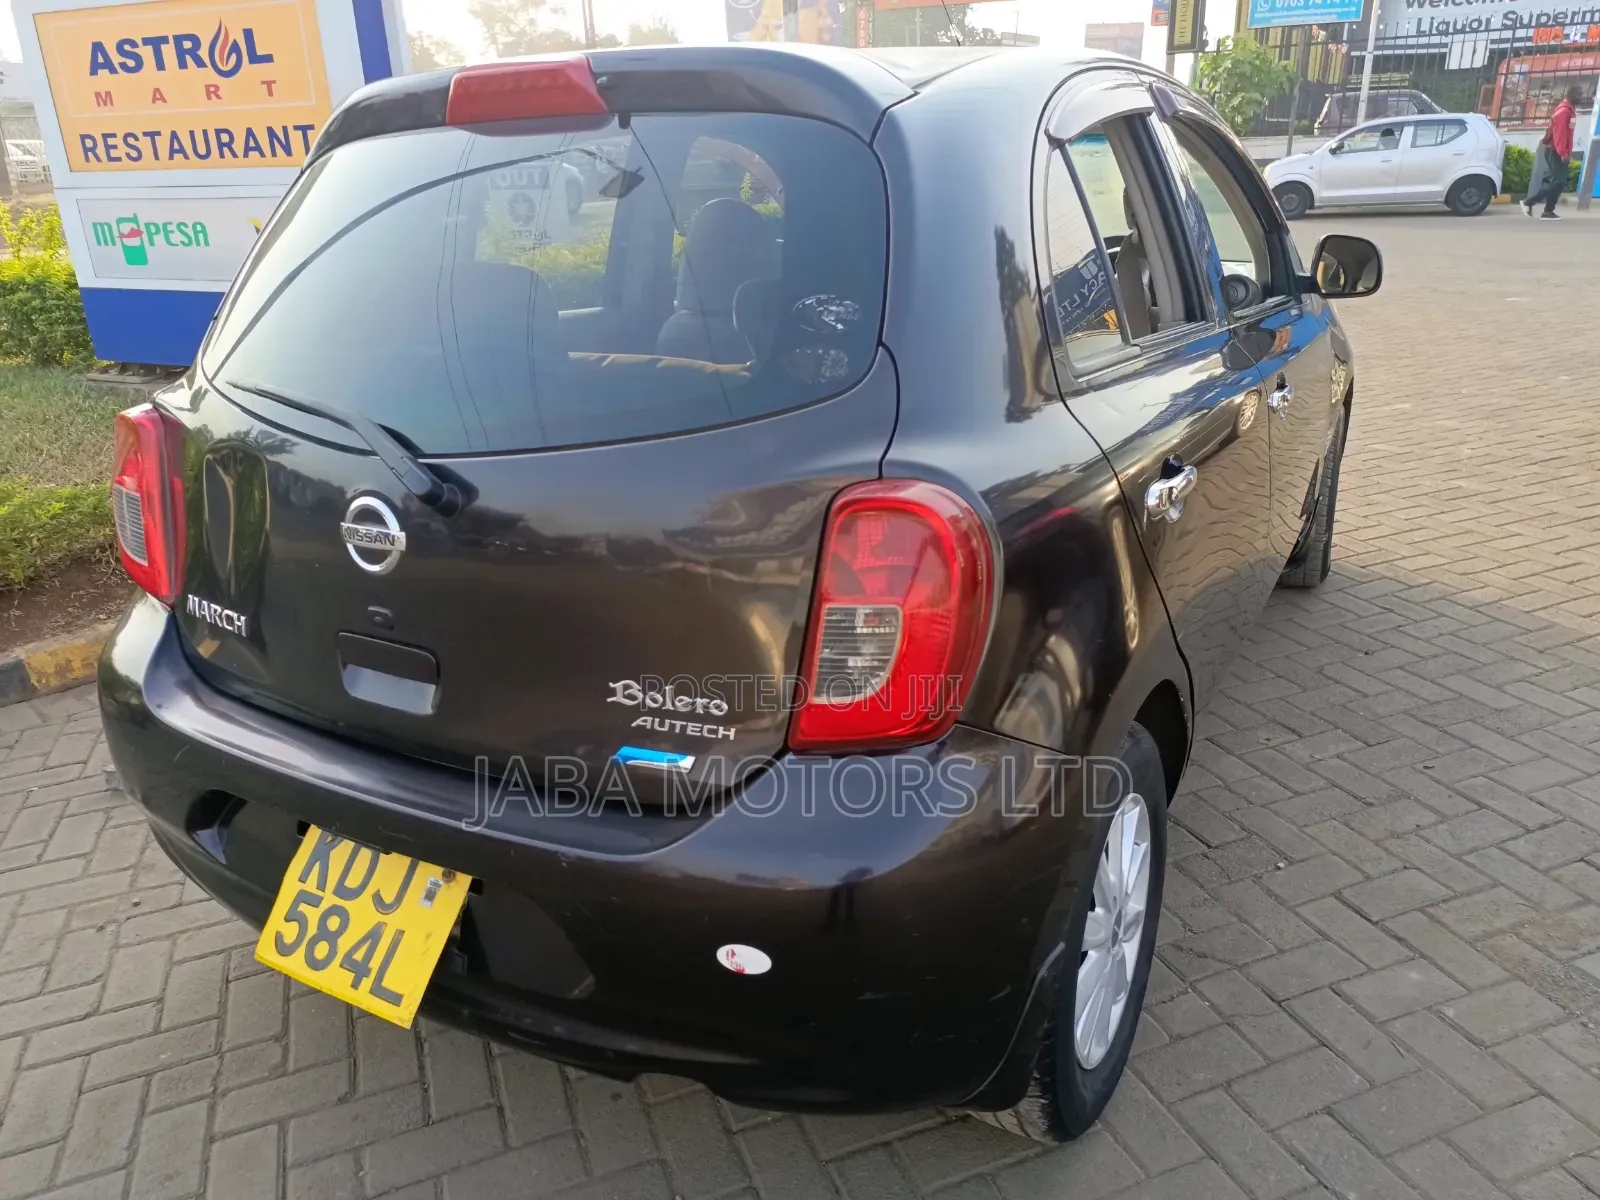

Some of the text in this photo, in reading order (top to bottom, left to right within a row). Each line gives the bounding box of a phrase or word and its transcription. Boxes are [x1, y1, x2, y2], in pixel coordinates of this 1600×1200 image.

[1405, 0, 1511, 10] Welco
[1415, 15, 1492, 37] Liquor
[94, 79, 277, 107] MART
[79, 124, 316, 164] RESTAURANT
[342, 525, 396, 547] NISSAN
[186, 594, 248, 638] MARCH
[606, 680, 728, 716] Bolero
[630, 716, 737, 741] AUTECH
[298, 828, 420, 916] KDJ
[274, 888, 406, 1008] 584L
